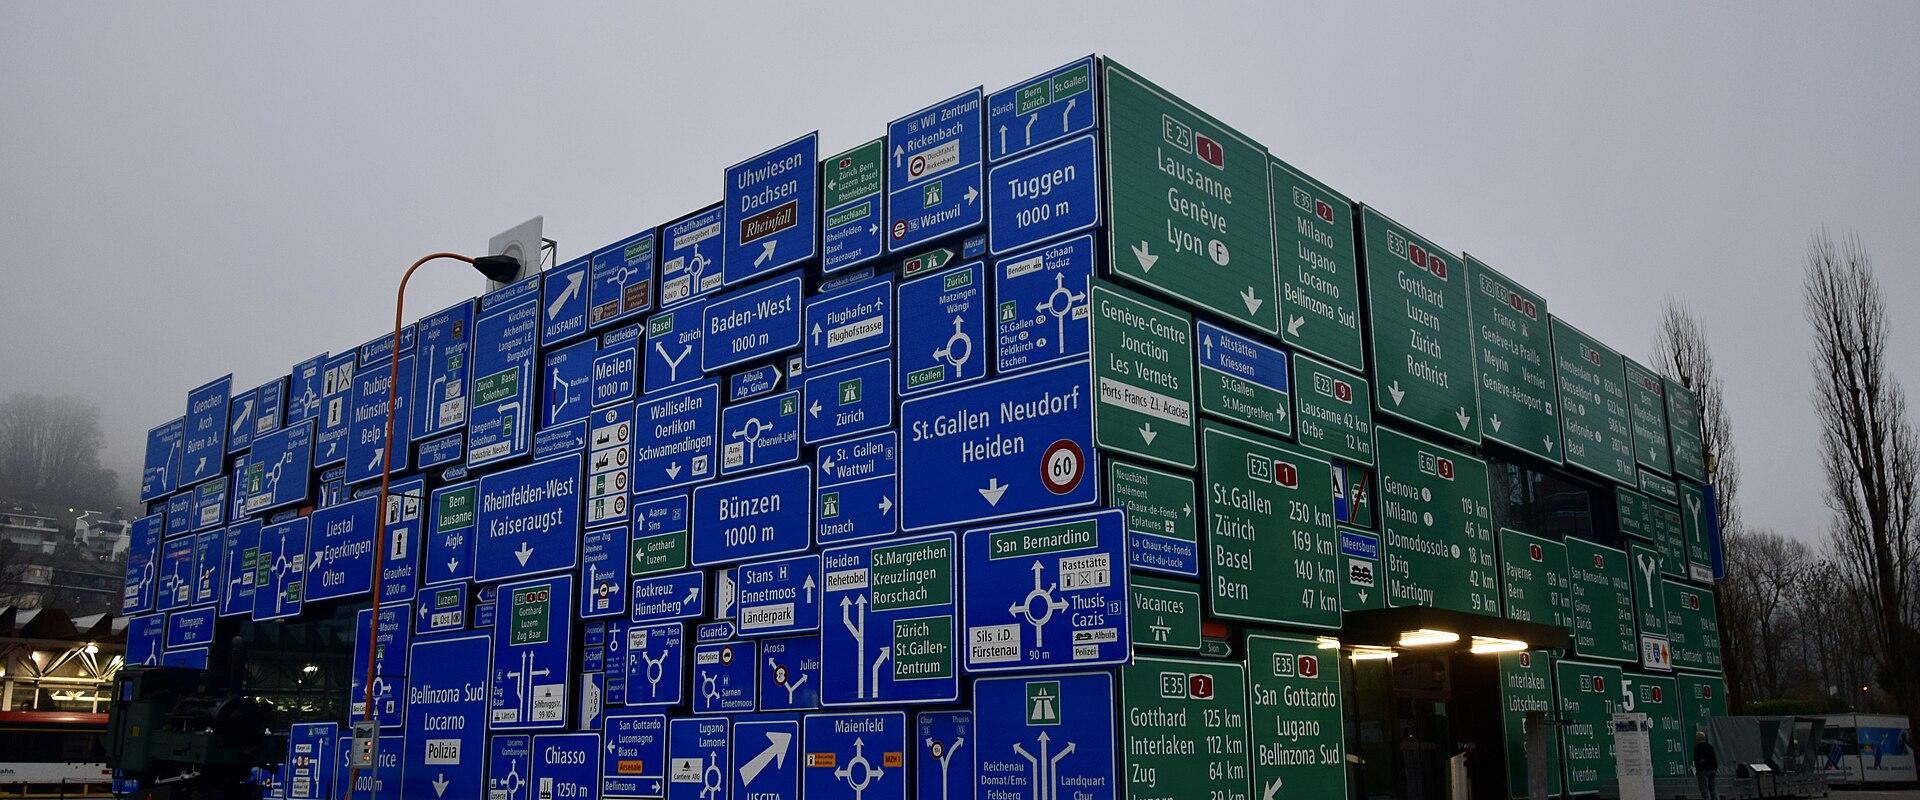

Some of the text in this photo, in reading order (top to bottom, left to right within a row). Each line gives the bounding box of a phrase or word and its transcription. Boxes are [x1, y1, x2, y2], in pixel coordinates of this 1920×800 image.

[1024, 86, 1041, 99] Bern
[910, 99, 978, 131] 16 Wil Zentrum
[992, 102, 1013, 116] Zürich
[907, 122, 963, 152] Rickenbach
[738, 153, 802, 190] Uhwiesen
[1158, 147, 1232, 204] Lausanne
[1008, 164, 1075, 200] Tuggen
[741, 179, 797, 212] Dachsen
[829, 208, 866, 226] Deutschland
[1016, 201, 1069, 228] 1000 m
[1168, 188, 1226, 234] Genève
[674, 215, 713, 236] Schaffhausen
[1298, 217, 1333, 248] Milano
[1045, 245, 1073, 260] Schaan
[1299, 241, 1336, 274] Lugano
[1046, 258, 1070, 271] Vaduz
[1298, 265, 1339, 299] Locarno
[1398, 270, 1443, 309] Gotthard
[939, 287, 976, 304] Matzingen
[711, 295, 791, 334] Baden-West
[827, 304, 871, 325] Flughafen
[1101, 300, 1185, 344] Genève-Centre
[1407, 300, 1439, 331] Luzern
[1494, 307, 1515, 332] France
[428, 329, 440, 340] Aigle
[547, 315, 583, 337] AUSFAHRT
[652, 321, 671, 333] Basel
[679, 329, 701, 344] Zürich
[731, 332, 769, 354] 1000 m
[445, 342, 468, 353] Martigny
[507, 347, 532, 362] Burgdorf
[1121, 332, 1168, 362] Jonction
[548, 354, 567, 367] Luzern
[1001, 355, 1026, 368] Eschen
[1220, 354, 1254, 376] Kriessern
[1484, 348, 1508, 372] Meyrin
[743, 371, 763, 384] Albula
[1111, 353, 1178, 390] Les Vernets
[1407, 354, 1447, 386] Rothrist
[1522, 367, 1545, 389] Vernier
[477, 372, 517, 391] Zürich Basel
[737, 381, 768, 396] Alp Grüm
[1222, 376, 1254, 397] St.Gallen
[194, 394, 221, 413] Grenchen
[651, 397, 702, 420] Wallisellen
[1563, 397, 1577, 414] Köln
[836, 409, 864, 426] Zürich
[913, 385, 1080, 442] St.Gallen Neudorf
[198, 417, 212, 430] Arch
[656, 420, 695, 438] Oerlikon
[319, 427, 347, 443] Münsingen
[361, 426, 380, 444] Belp
[1302, 421, 1369, 454] Orbe 12 km
[639, 435, 711, 461] Schwamendingen
[962, 434, 1024, 463] Heiden
[1568, 440, 1585, 457] Basel
[837, 460, 874, 478] Wattwil
[1054, 457, 1071, 477] 60
[1116, 469, 1148, 485] Neuchâtel
[484, 477, 573, 513] Rheinfelden-West
[1117, 484, 1147, 499] Delémont
[449, 496, 465, 508] Bern
[719, 494, 780, 521] Bünzen
[327, 515, 354, 537] Liestal
[440, 511, 472, 526] Lausanne
[490, 508, 563, 538] Kaiseraugst
[1386, 501, 1489, 541] Milano 46 km
[996, 530, 1090, 553] San Bernardino
[1216, 514, 1333, 556] Zürich 169 km
[325, 540, 370, 564] Egerkingen
[648, 539, 674, 552] Gotthard
[1343, 536, 1376, 557] Meersburg
[1062, 557, 1107, 571] Raststätte
[1217, 545, 1334, 584] Basel 140 km
[1390, 554, 1493, 589] Brig 42 km
[873, 568, 936, 585] Kreuzlingen
[636, 584, 673, 598] Rotkreuz
[741, 586, 796, 604] Ennetmoos
[874, 586, 927, 604] Rorschach
[1392, 579, 1496, 612] Martigny 59 km
[1574, 584, 1584, 596] Chur
[438, 595, 458, 605] Luzern
[635, 600, 681, 616] Hünenberg
[1135, 593, 1184, 614] Vacances
[519, 607, 542, 616] Gotthard
[743, 608, 792, 624] Länderpark
[1072, 612, 1104, 627] Cazis
[1511, 605, 1530, 621] Aarau
[1561, 613, 1572, 627] km
[180, 617, 203, 628] Champagne
[522, 620, 538, 628] Luzern
[700, 625, 727, 637] Guarda
[896, 622, 928, 638] Zürich
[977, 629, 1013, 642] Sils i.D.
[1578, 635, 1594, 646] Luzern
[764, 644, 784, 653] Arosa
[973, 645, 1018, 662] Fürstenau
[1208, 643, 1219, 653] Sion
[896, 660, 940, 674] Zentrum
[1508, 672, 1544, 690] Interlaken
[411, 681, 484, 705] Bellinzona Sud
[1255, 684, 1336, 707] San Gottardo
[424, 713, 464, 730] Locarno
[619, 721, 660, 729] San Gottardo
[835, 718, 883, 733] Maienfeld
[1277, 715, 1319, 742] Lugano
[619, 734, 652, 743] Lucomagno
[1131, 735, 1242, 755] Interlaken 112 km
[429, 743, 457, 759] Polizia
[546, 747, 585, 764] Chiasso
[1260, 743, 1339, 766] Bellinzona Sud
[984, 762, 1024, 772] Reichenau
[1133, 761, 1244, 787] Zug 64 km
[982, 775, 1026, 786] Domat/Ems
[557, 783, 587, 797] 1250 m
